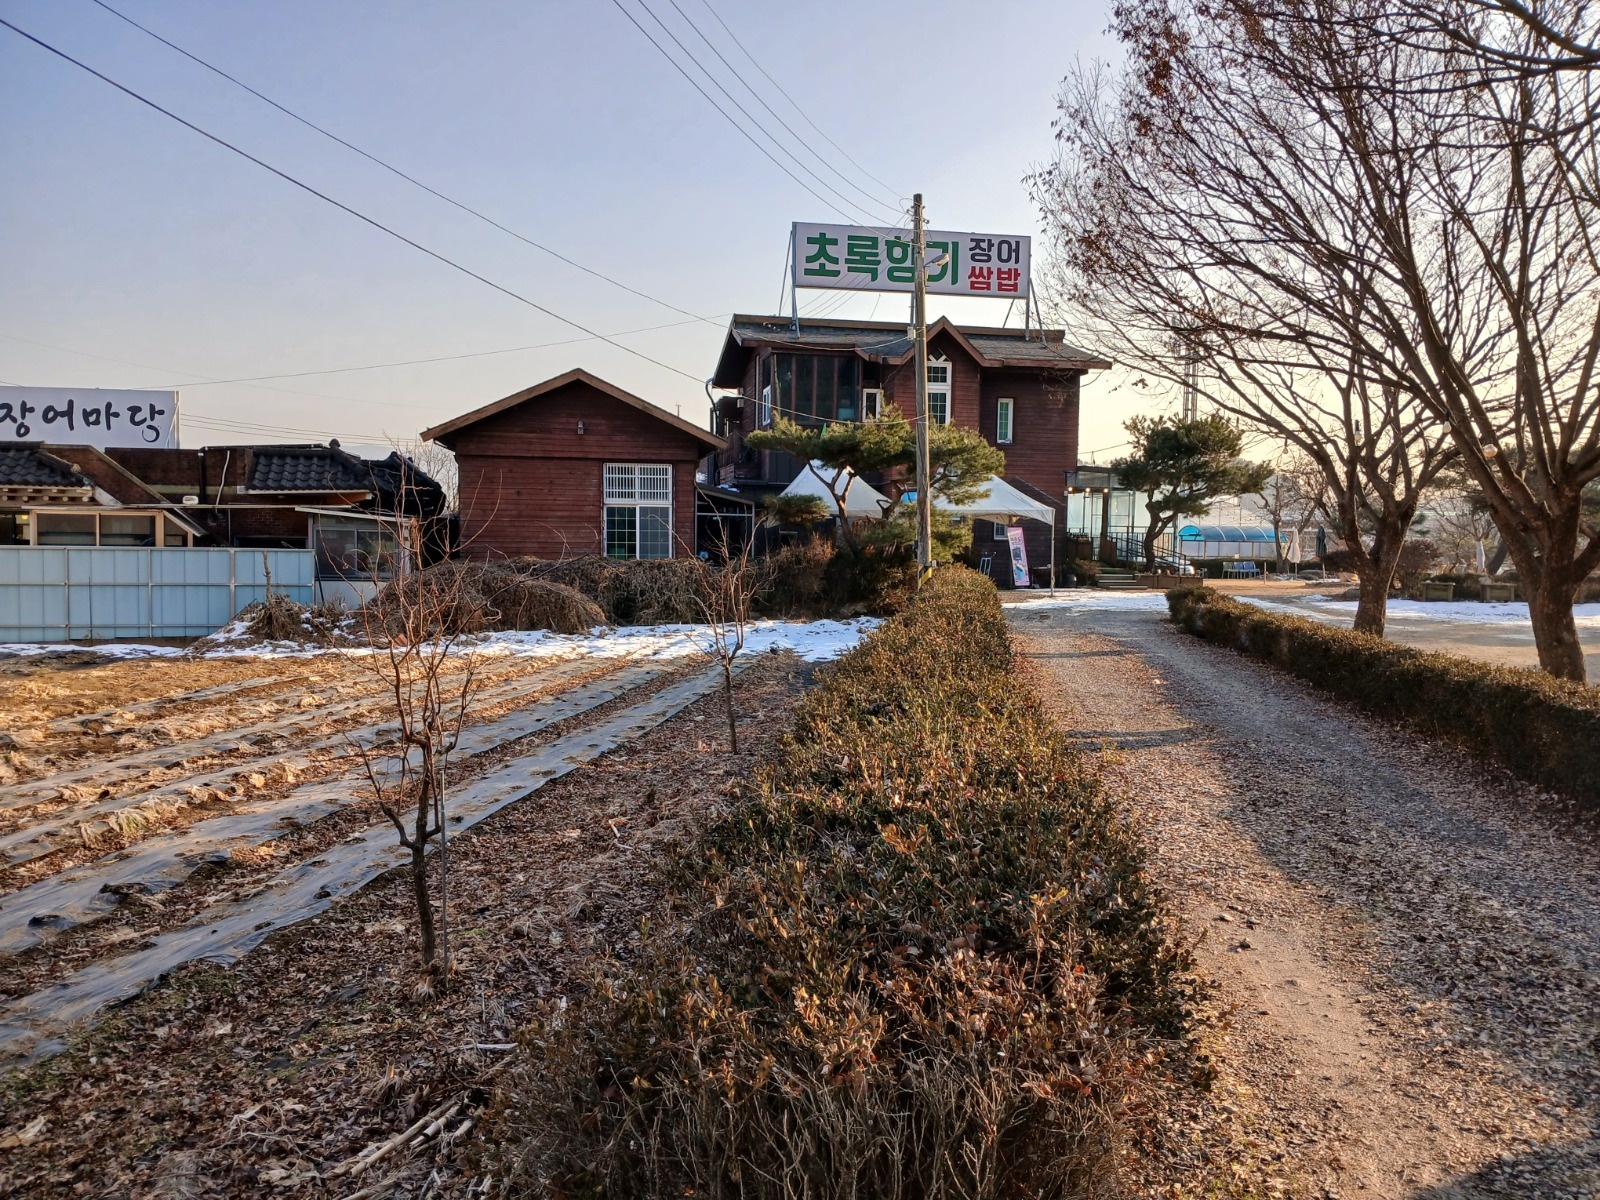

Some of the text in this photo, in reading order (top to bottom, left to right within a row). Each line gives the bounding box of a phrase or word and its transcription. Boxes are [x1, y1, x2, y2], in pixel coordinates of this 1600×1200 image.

[968, 238, 1020, 264] 장어
[967, 265, 1021, 293] 쌈밥
[0, 398, 166, 443] 장어마당
